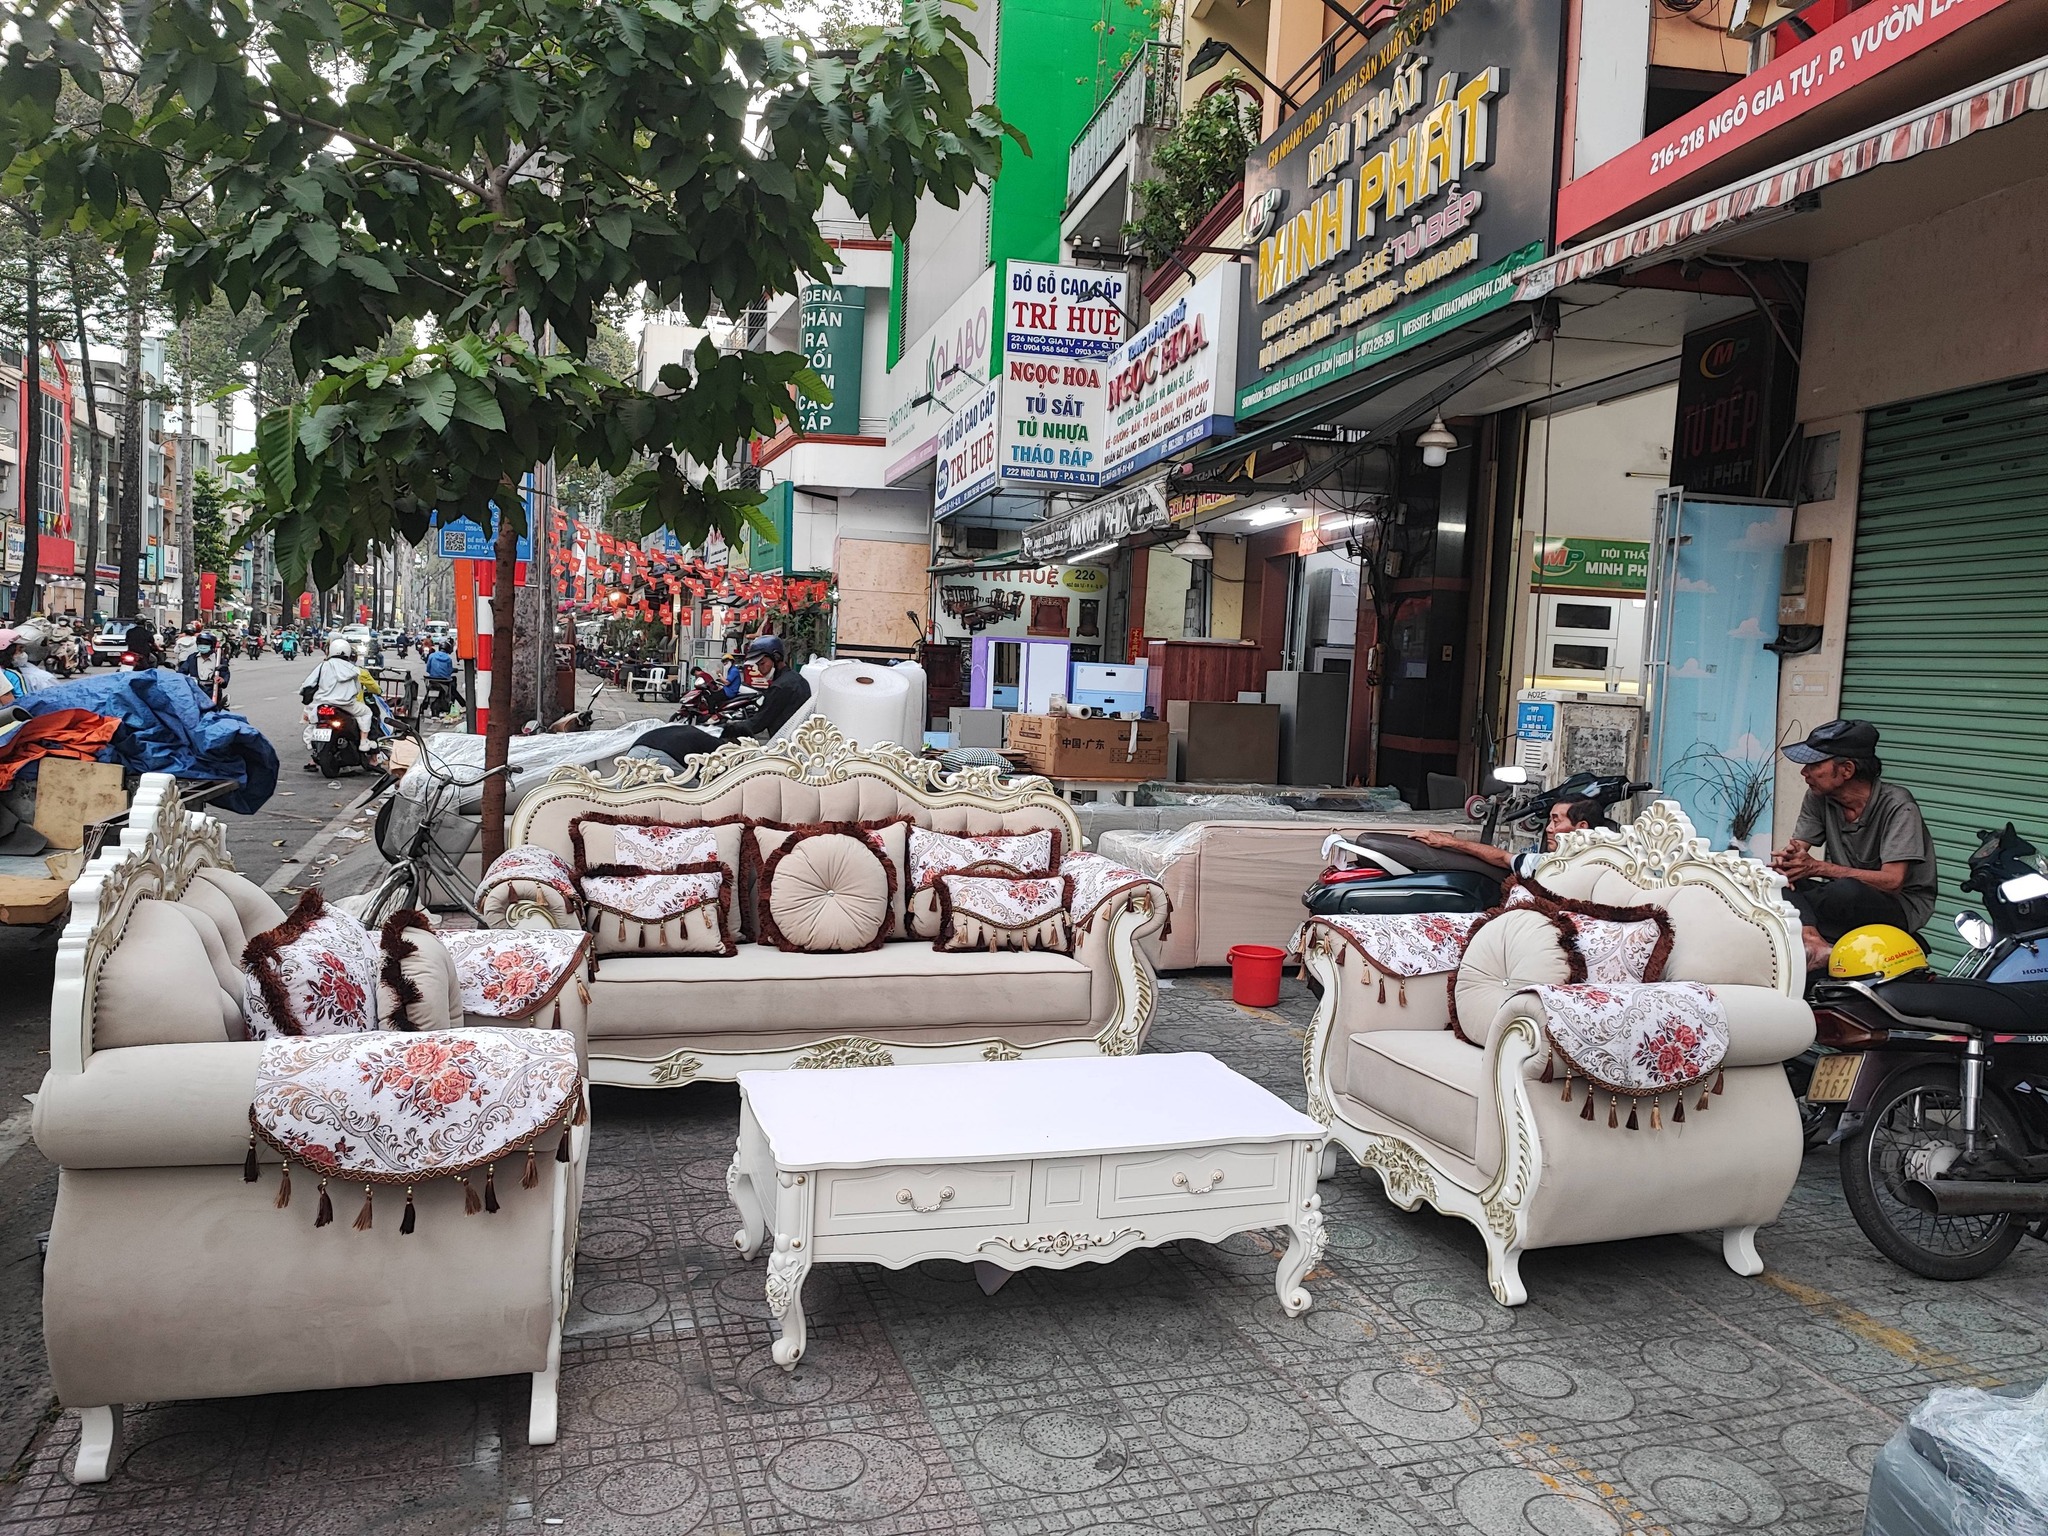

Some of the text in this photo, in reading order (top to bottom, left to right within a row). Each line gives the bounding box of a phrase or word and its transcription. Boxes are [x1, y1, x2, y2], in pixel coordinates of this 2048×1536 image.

[1352, 52, 1429, 150] THẤT
[1649, 131, 1704, 175] 216-218
[1708, 97, 1748, 142] NGÔ
[1752, 86, 1784, 117] GIA
[1790, 55, 1823, 98] TỰ,
[1829, 45, 1845, 75] P.
[1851, 0, 1924, 60] VƯỜN
[1325, 94, 1335, 119] TY
[1257, 66, 1500, 304] MINH PHÁT
[1391, 183, 1482, 267] TỦ BẾP
[1405, 233, 1478, 294] SHOWROOM
[1013, 268, 1032, 292] ĐỒ
[1037, 270, 1056, 294] GỖ
[1061, 278, 1089, 301] CAO
[801, 308, 842, 329] CHĂN
[1012, 296, 1121, 341] TRÍ HUỆ
[805, 332, 829, 348] RA
[1011, 334, 1025, 343] 226
[1027, 335, 1046, 344] NGÔ
[1048, 337, 1063, 346] GIA
[1010, 361, 1060, 389] NGỌC
[1063, 366, 1101, 389] HOA
[1107, 313, 1209, 412] NGỌC HOA
[965, 404, 978, 433] CAO
[980, 385, 996, 421] CẤP
[1026, 392, 1084, 418] TỦ SẮT
[1017, 416, 1089, 444] TỦ NHỰA
[951, 440, 967, 487] TRÍ
[971, 421, 994, 474] HUỆ
[1006, 467, 1019, 476] 222
[1021, 467, 1035, 478] NGÔ
[1037, 469, 1048, 478] GIA
[1050, 471, 1059, 480] TỰ
[1080, 474, 1095, 483] Q.10
[1601, 548, 1620, 559] NỘI
[1075, 569, 1095, 581] 226
[1585, 561, 1647, 577] MINH PH
[1062, 737, 1105, 750] 中国·广东
[1813, 1078, 1849, 1098] 5167
